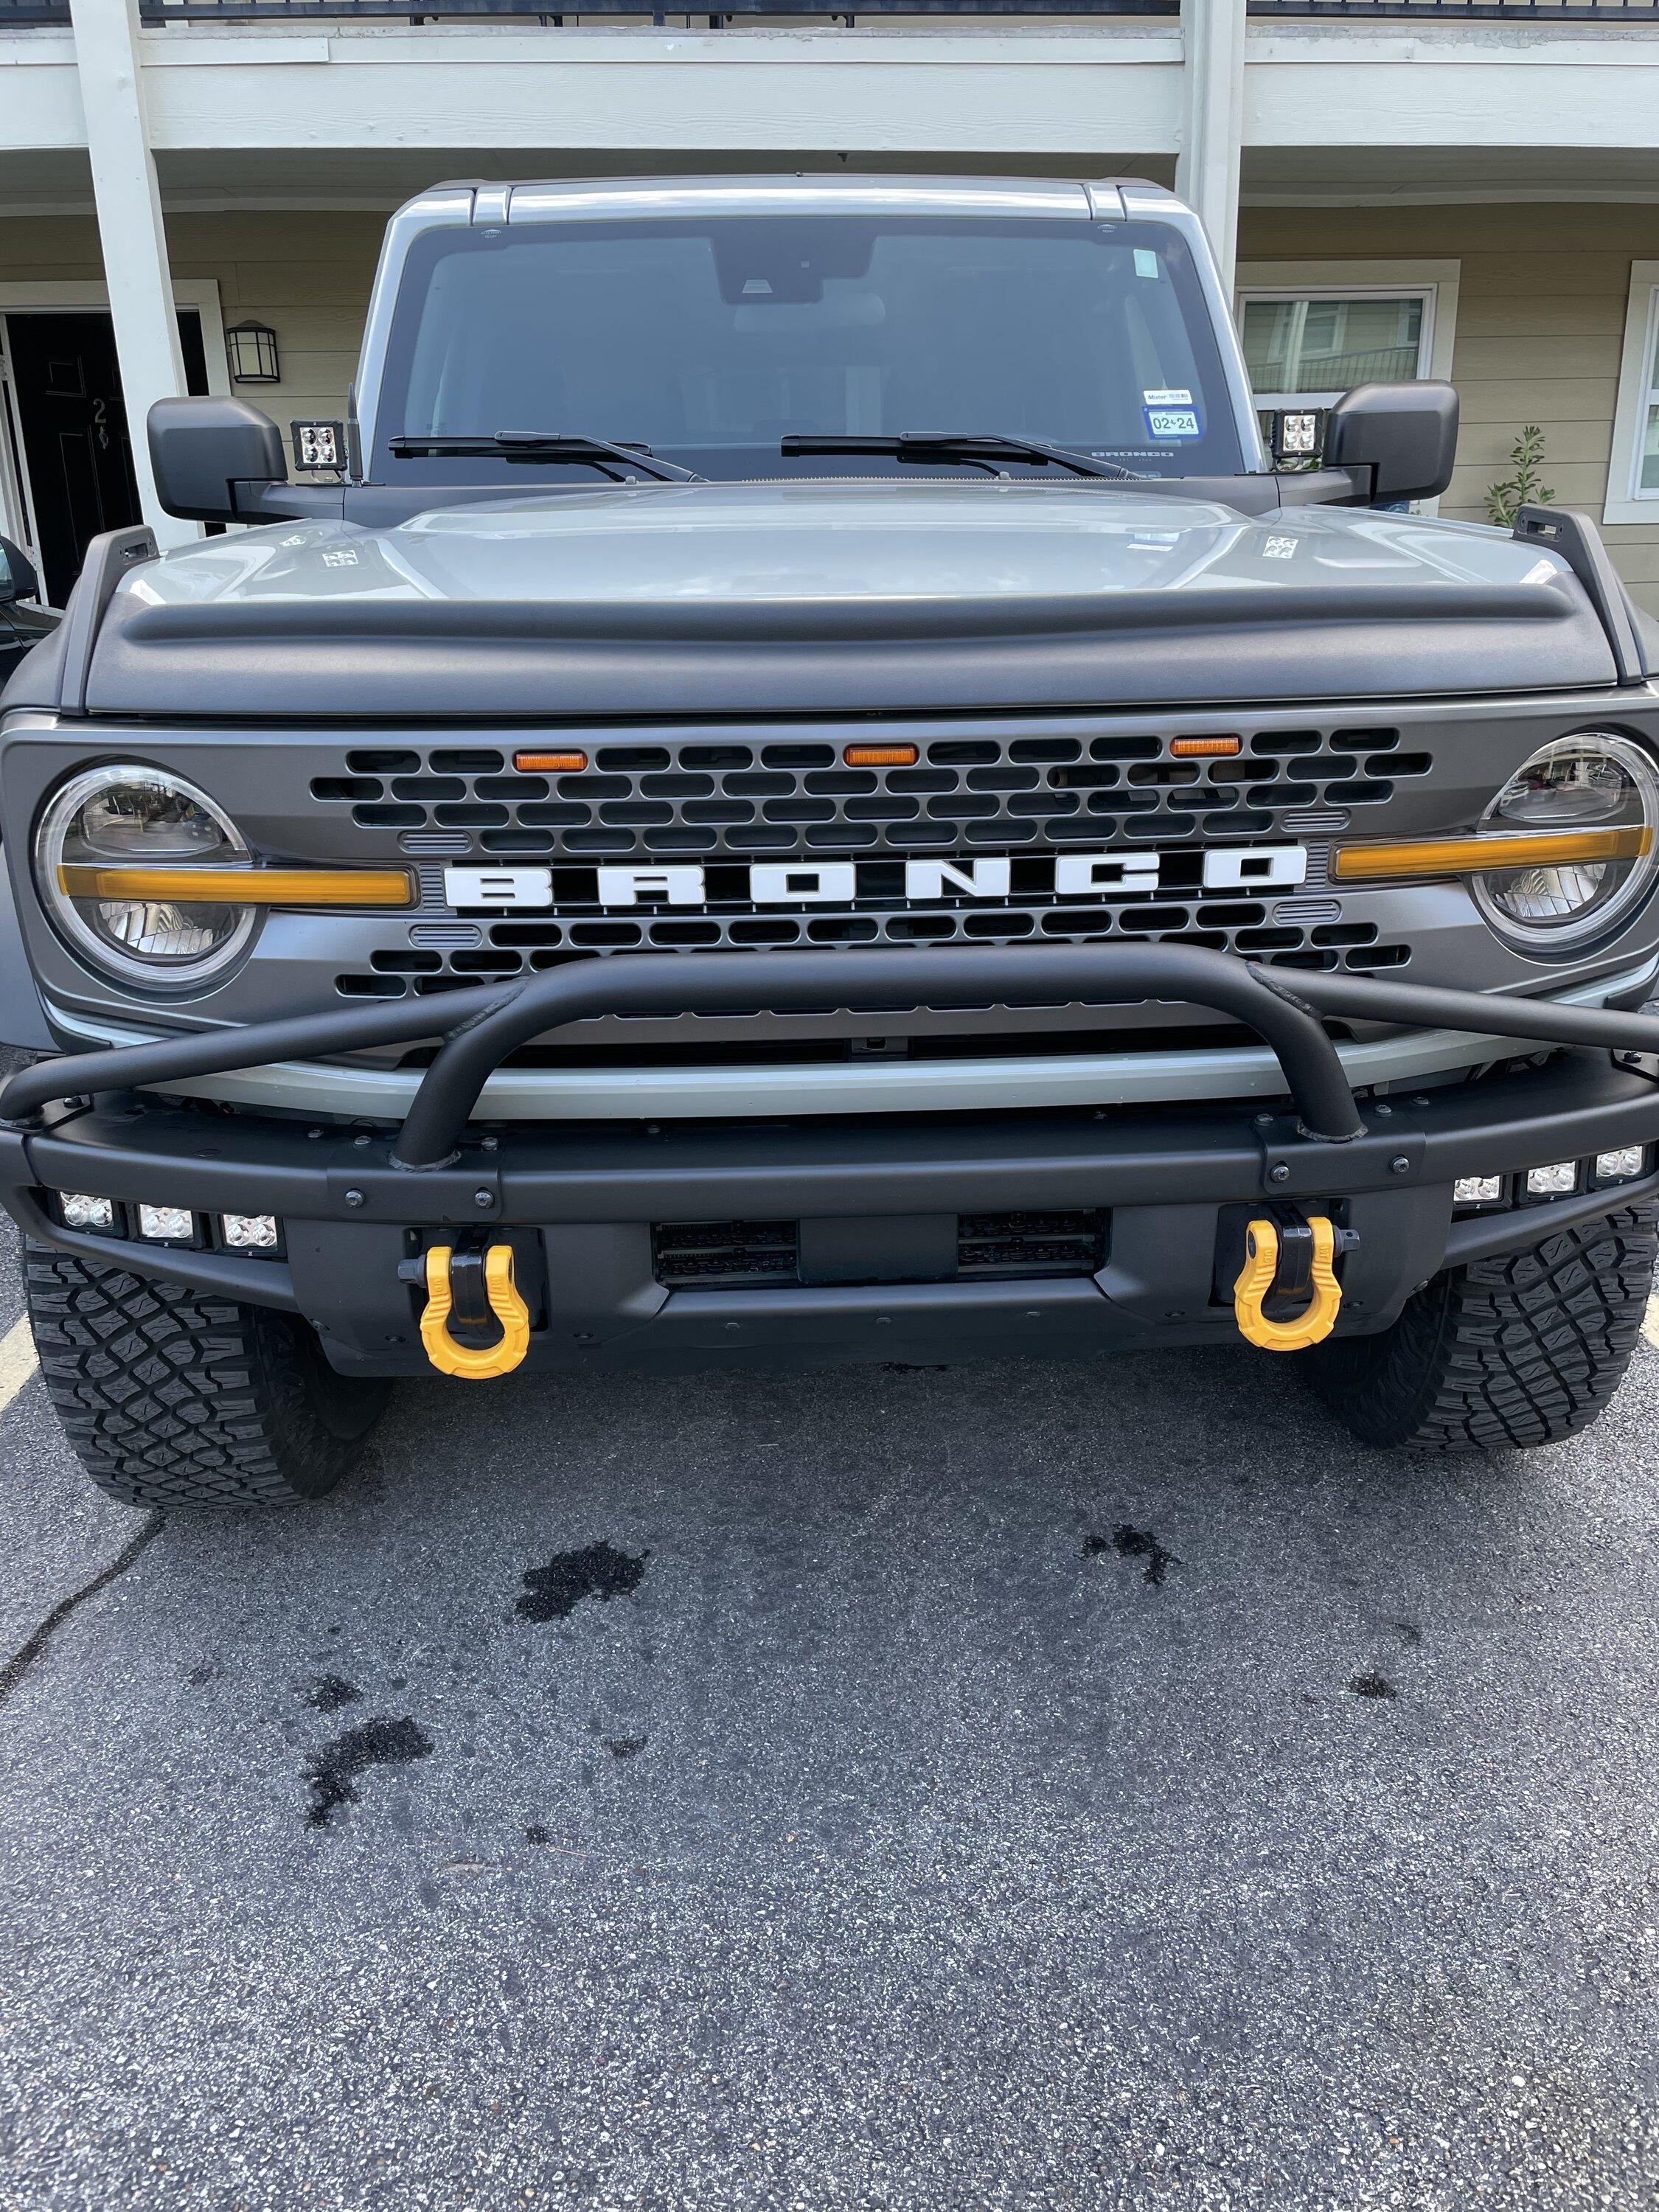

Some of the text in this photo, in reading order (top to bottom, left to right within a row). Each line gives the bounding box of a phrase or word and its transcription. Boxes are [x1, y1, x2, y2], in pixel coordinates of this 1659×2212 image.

[1152, 417, 1194, 429] 02 24
[444, 846, 1308, 908] BRONCO
